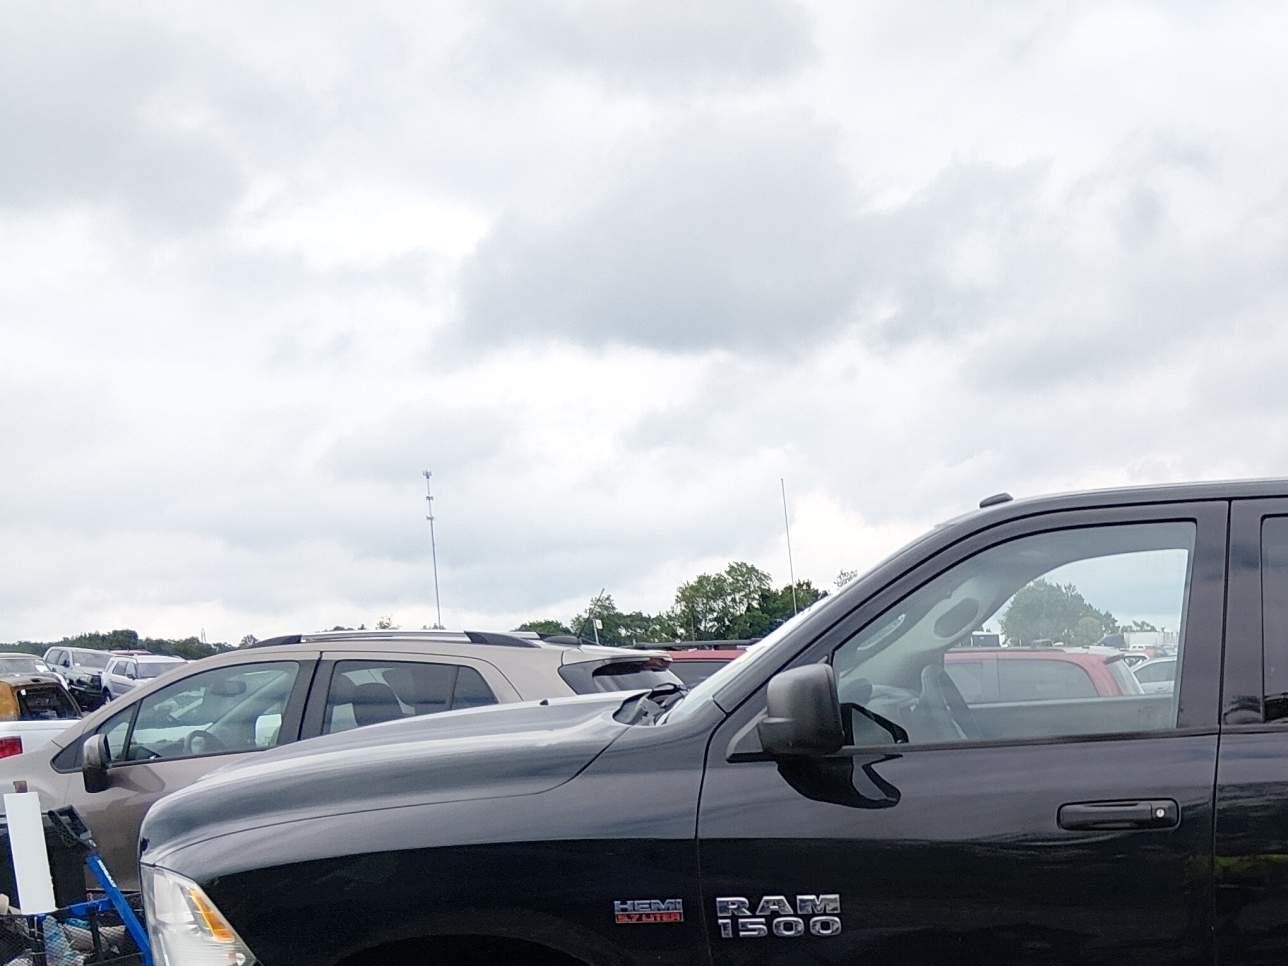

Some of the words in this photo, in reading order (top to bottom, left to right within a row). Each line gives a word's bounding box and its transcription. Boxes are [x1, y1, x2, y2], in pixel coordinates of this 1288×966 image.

[614, 899, 683, 912] HEMI
[716, 894, 841, 916] RAM
[642, 912, 680, 922] LITER
[717, 916, 842, 938] 1500
